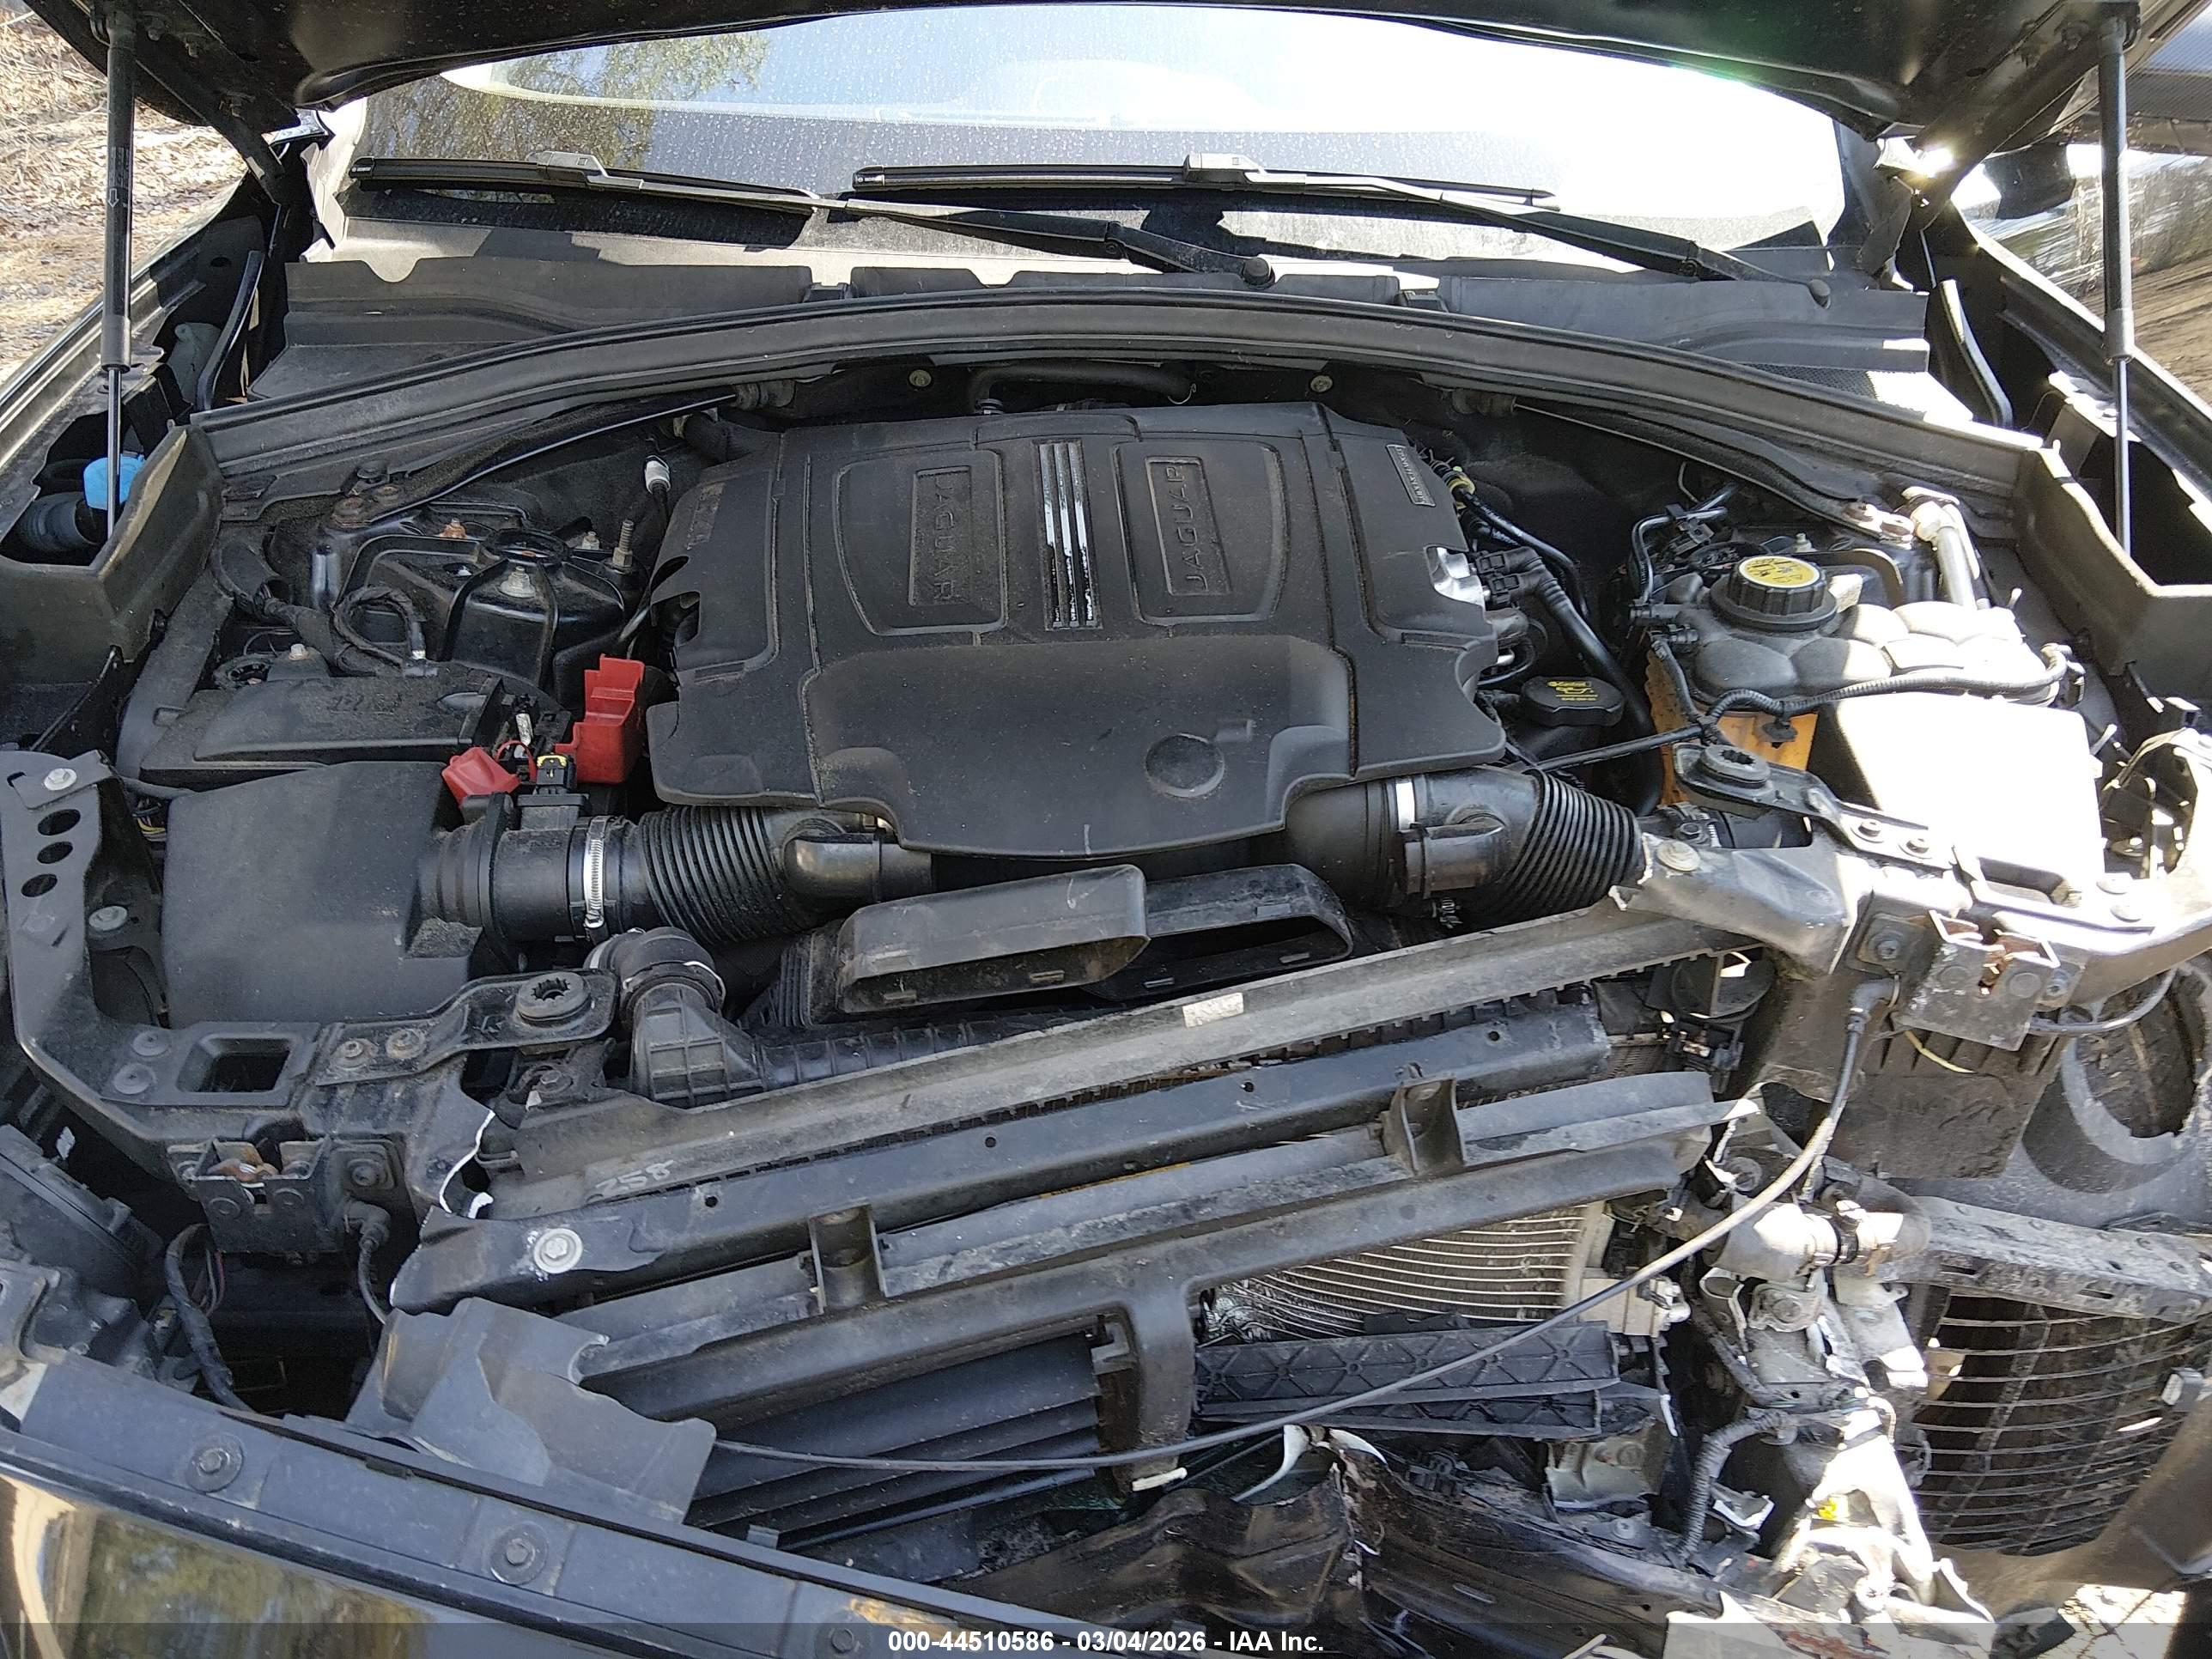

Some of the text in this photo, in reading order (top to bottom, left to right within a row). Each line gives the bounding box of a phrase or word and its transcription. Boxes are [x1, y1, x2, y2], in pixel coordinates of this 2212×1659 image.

[933, 475, 958, 599] JAGUAR
[1166, 466, 1208, 591] JAGUAR
[594, 1159, 674, 1197] 258
